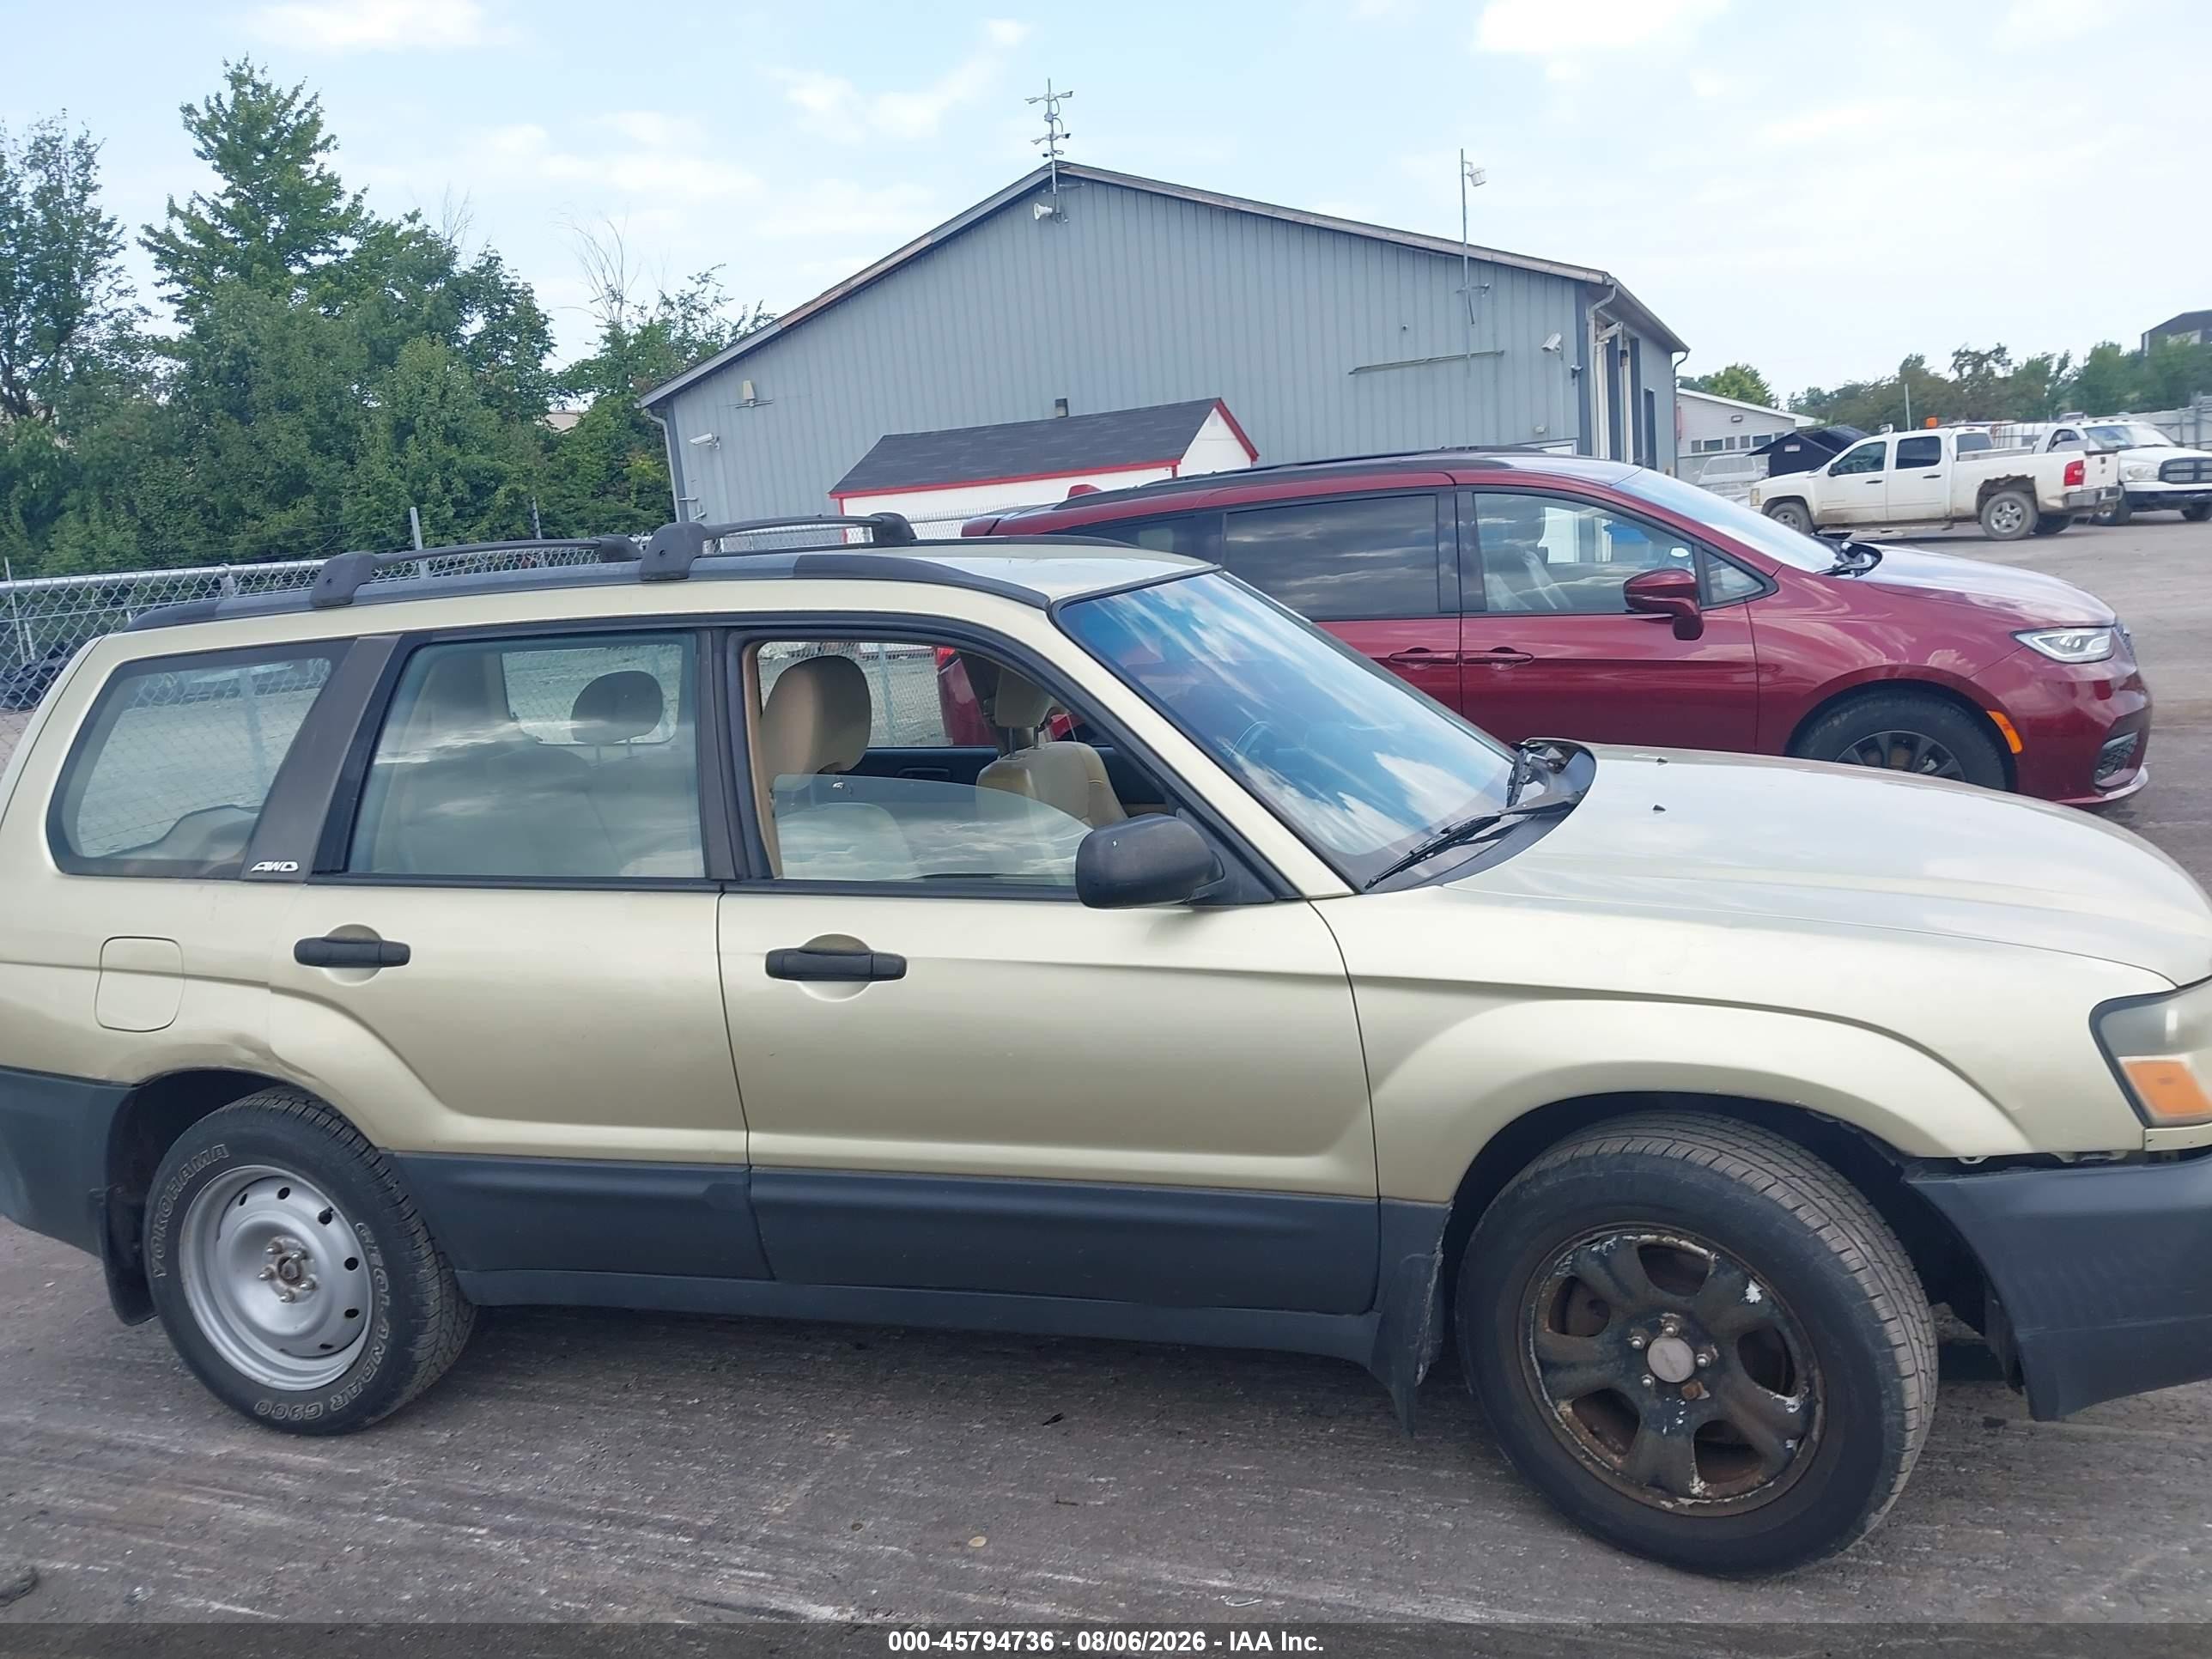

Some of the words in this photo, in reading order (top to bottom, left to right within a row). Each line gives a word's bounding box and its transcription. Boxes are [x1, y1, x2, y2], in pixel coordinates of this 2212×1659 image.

[250, 861, 299, 872] AWD
[149, 1143, 230, 1278] YOKOHAMA
[253, 1401, 324, 1421] G900
